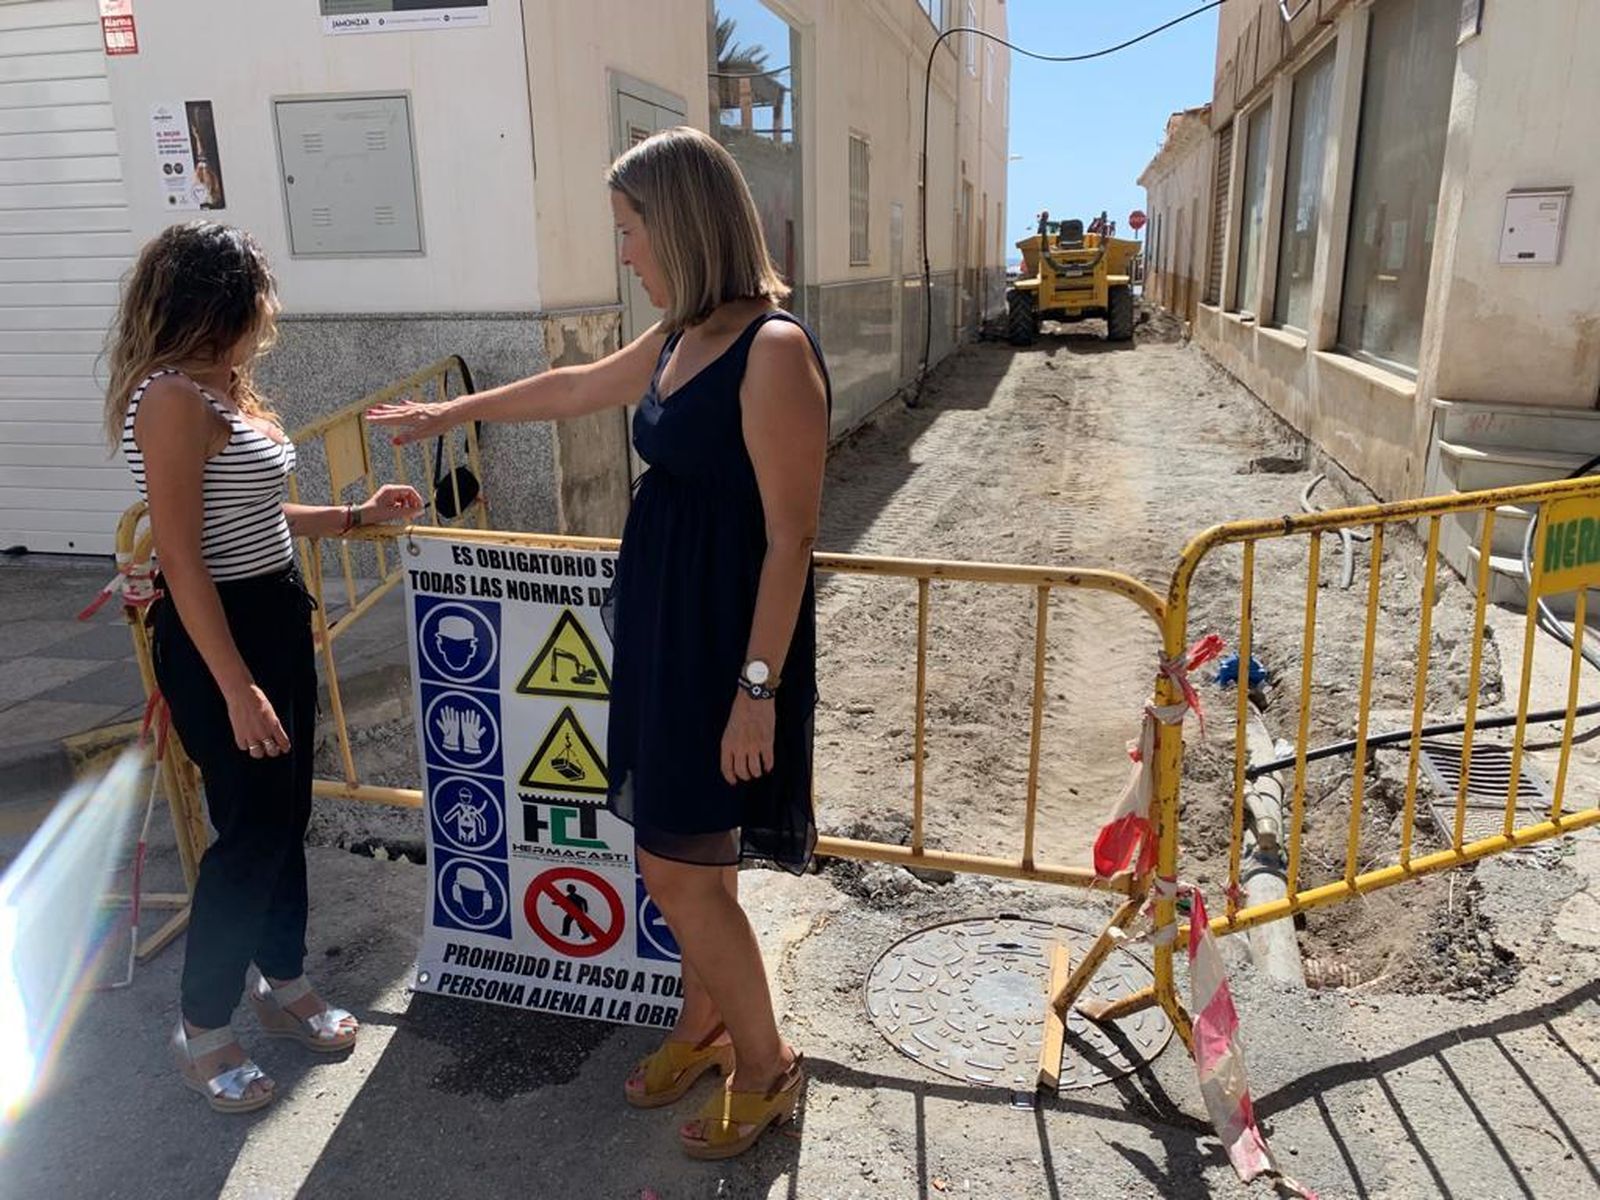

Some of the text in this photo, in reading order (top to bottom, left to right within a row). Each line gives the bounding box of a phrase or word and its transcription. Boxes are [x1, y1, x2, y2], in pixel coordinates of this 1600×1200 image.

[451, 545, 616, 578] ES OBLIGATORIO S
[1543, 516, 1600, 573] HER
[408, 570, 466, 595] TODAS
[470, 575, 504, 599] LAS
[506, 580, 584, 607] NORMAS
[512, 843, 629, 862] HERMACASTI
[442, 943, 550, 979] PROHIBIDO
[552, 960, 572, 982] EL
[576, 964, 628, 992] PASO
[630, 971, 645, 993] A
[437, 973, 679, 1028] PERSONA AJENA A LA OBR
